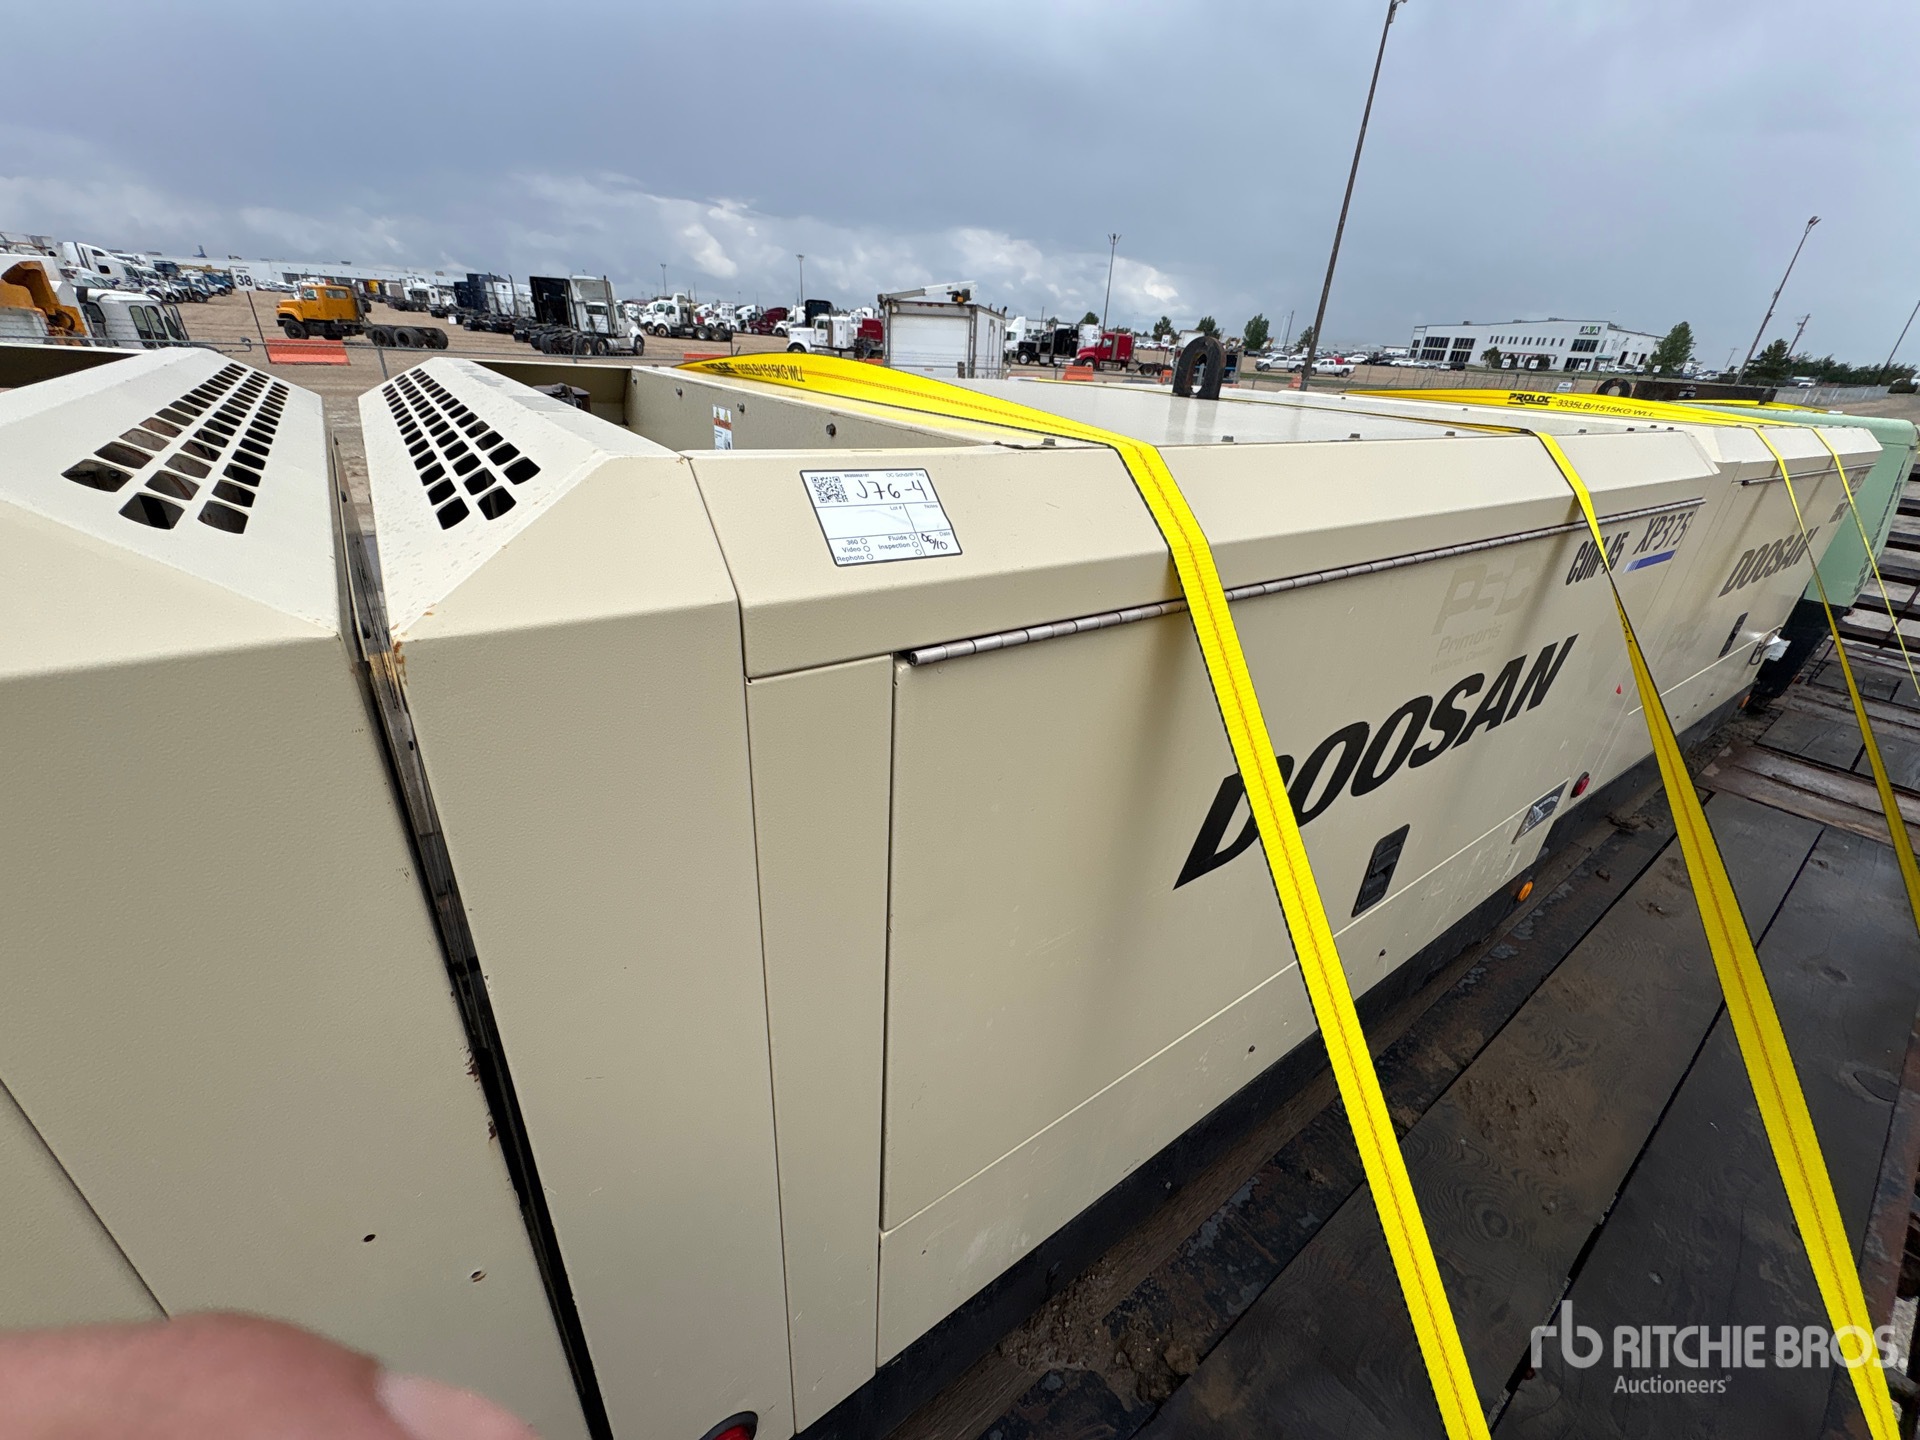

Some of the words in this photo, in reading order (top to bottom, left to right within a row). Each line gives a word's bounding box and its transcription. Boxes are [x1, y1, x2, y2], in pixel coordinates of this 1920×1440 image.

[236, 274, 253, 287] 38
[1508, 393, 1552, 404] PROLOC
[878, 542, 911, 550] Inspection
[1632, 511, 1694, 556] XP375
[1717, 526, 1820, 598] DOOSAN
[1173, 633, 1580, 890] DOOSAN
